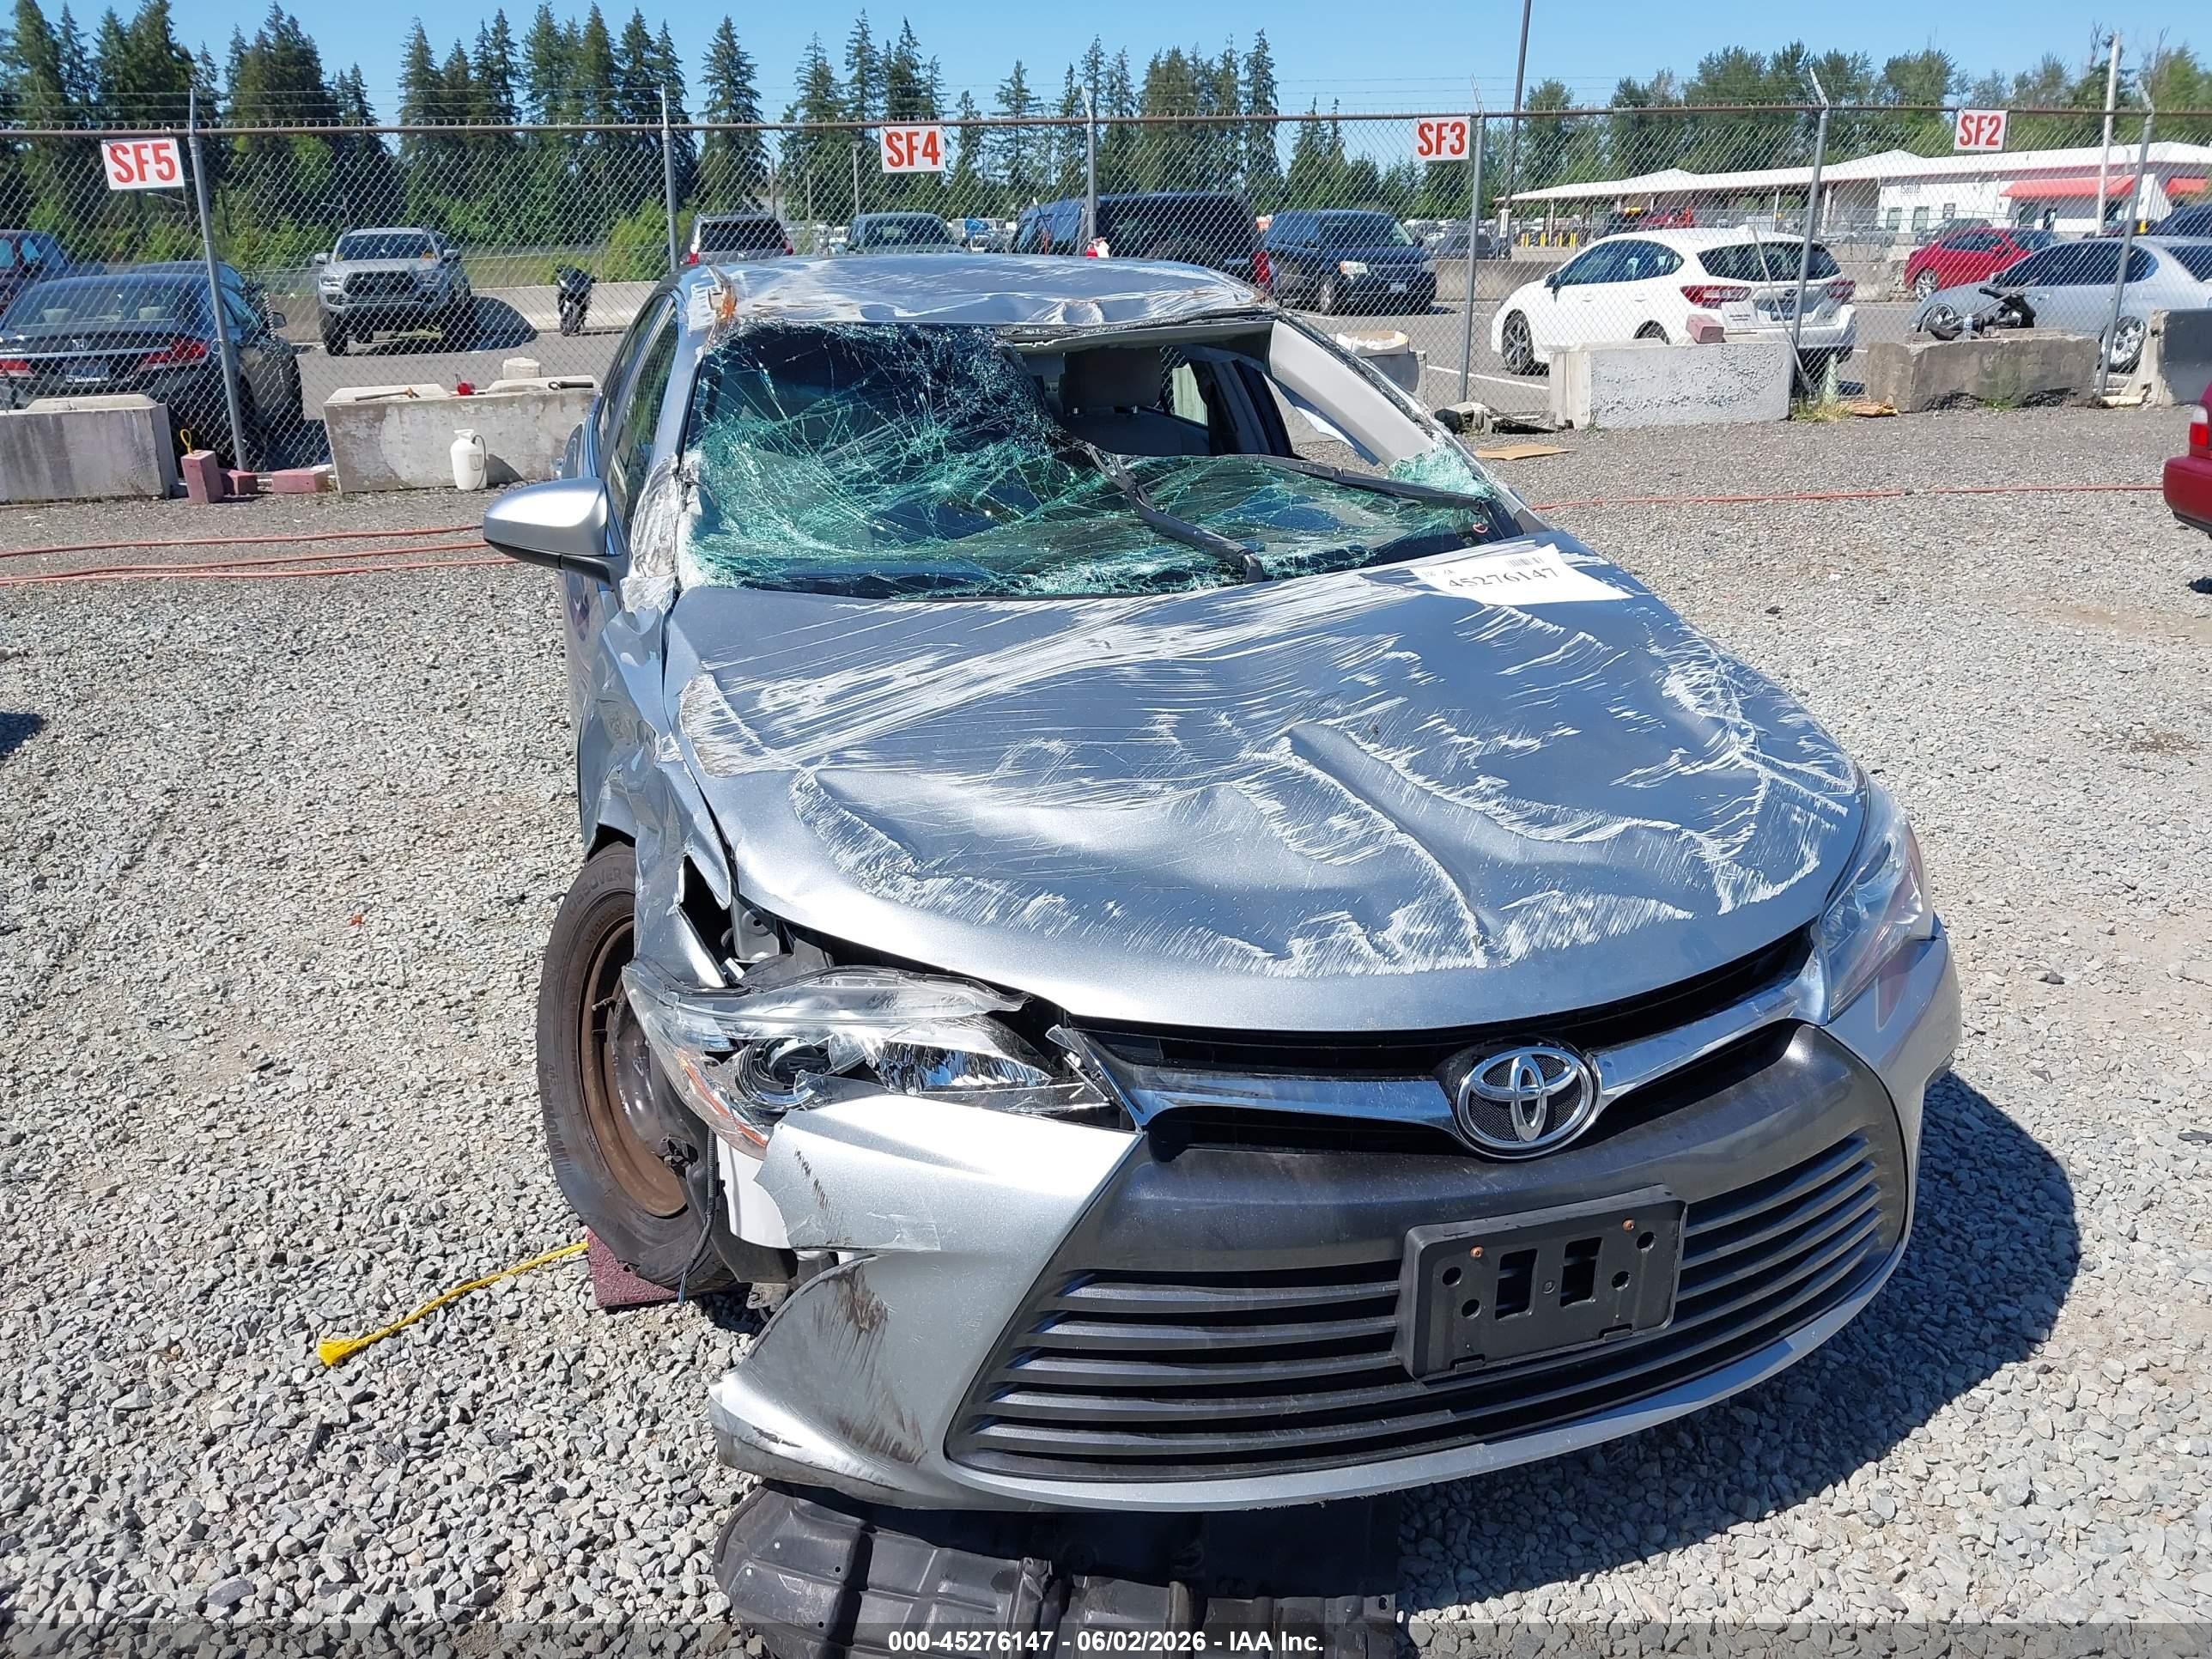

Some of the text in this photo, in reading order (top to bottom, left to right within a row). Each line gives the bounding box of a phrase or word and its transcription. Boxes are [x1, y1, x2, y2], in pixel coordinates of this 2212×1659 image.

[1418, 122, 1466, 156] SF3
[1959, 114, 2002, 146] SF2
[109, 143, 175, 183] SF5
[885, 131, 940, 167] SF4
[1449, 567, 1559, 586] 45276147
